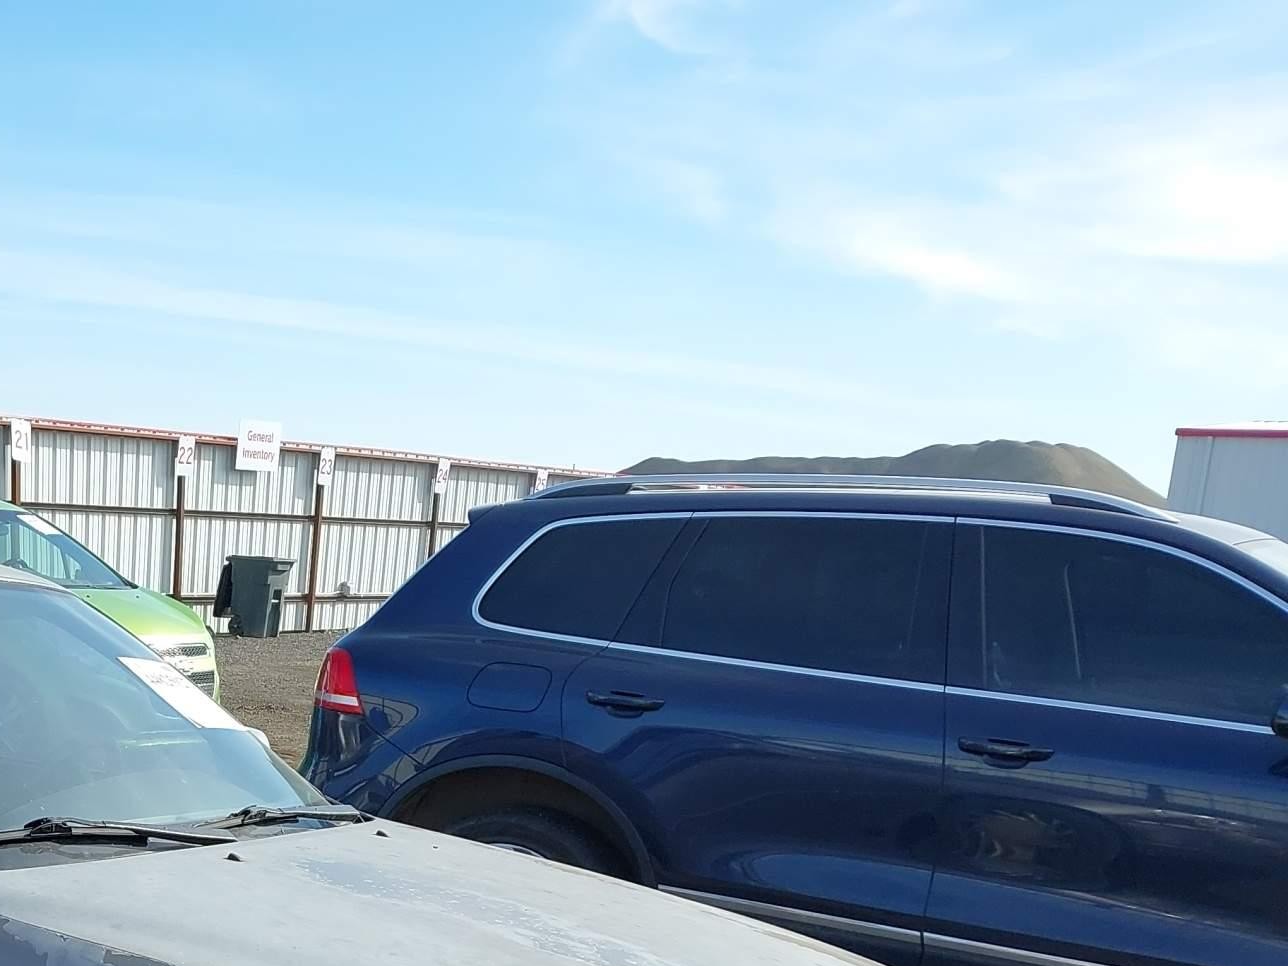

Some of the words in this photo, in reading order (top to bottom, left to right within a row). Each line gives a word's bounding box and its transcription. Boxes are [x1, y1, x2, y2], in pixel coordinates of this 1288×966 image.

[14, 430, 30, 452] 21
[247, 430, 274, 444] General
[177, 446, 194, 466] 22
[319, 458, 333, 476] 23
[437, 468, 450, 484] 24
